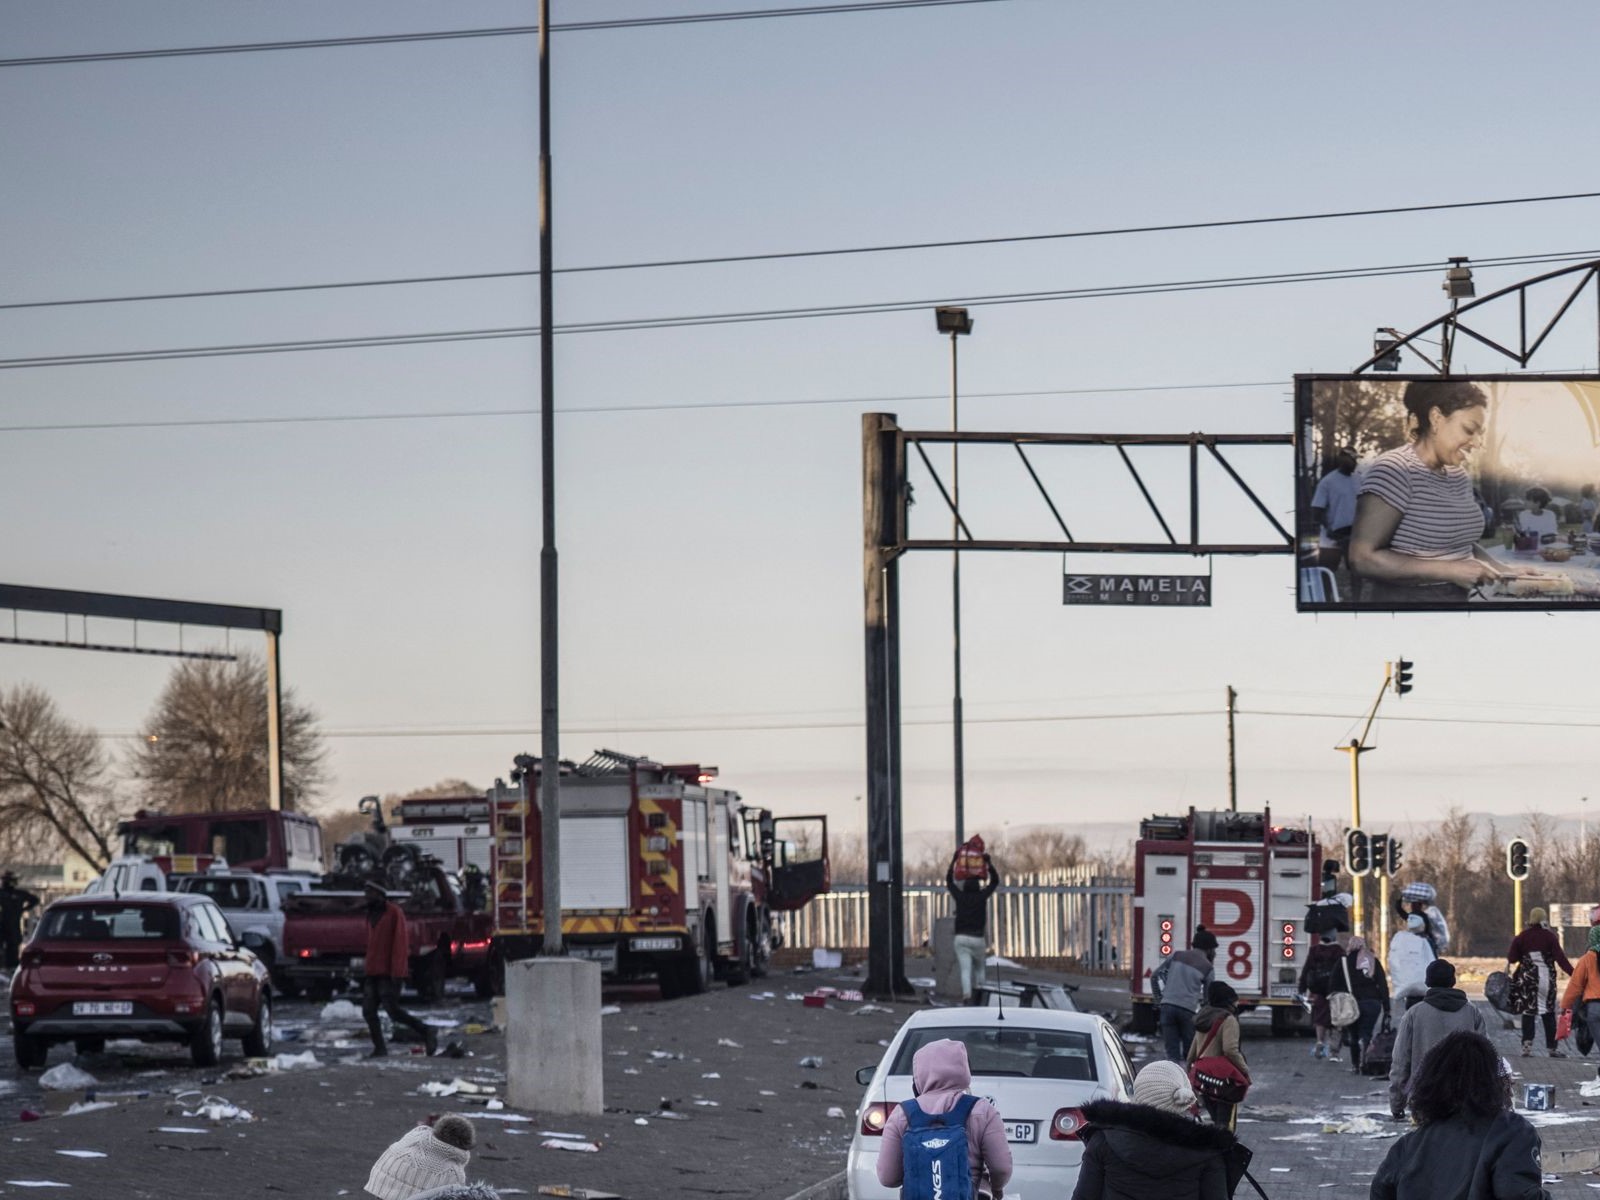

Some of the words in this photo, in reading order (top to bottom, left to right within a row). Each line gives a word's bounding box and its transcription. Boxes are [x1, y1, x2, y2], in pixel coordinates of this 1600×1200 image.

[1100, 578, 1206, 592] MAMELA
[1099, 594, 1206, 602] MEDIA
[1200, 888, 1255, 937] D
[1226, 941, 1253, 980] 8
[1015, 1125, 1031, 1139] GP
